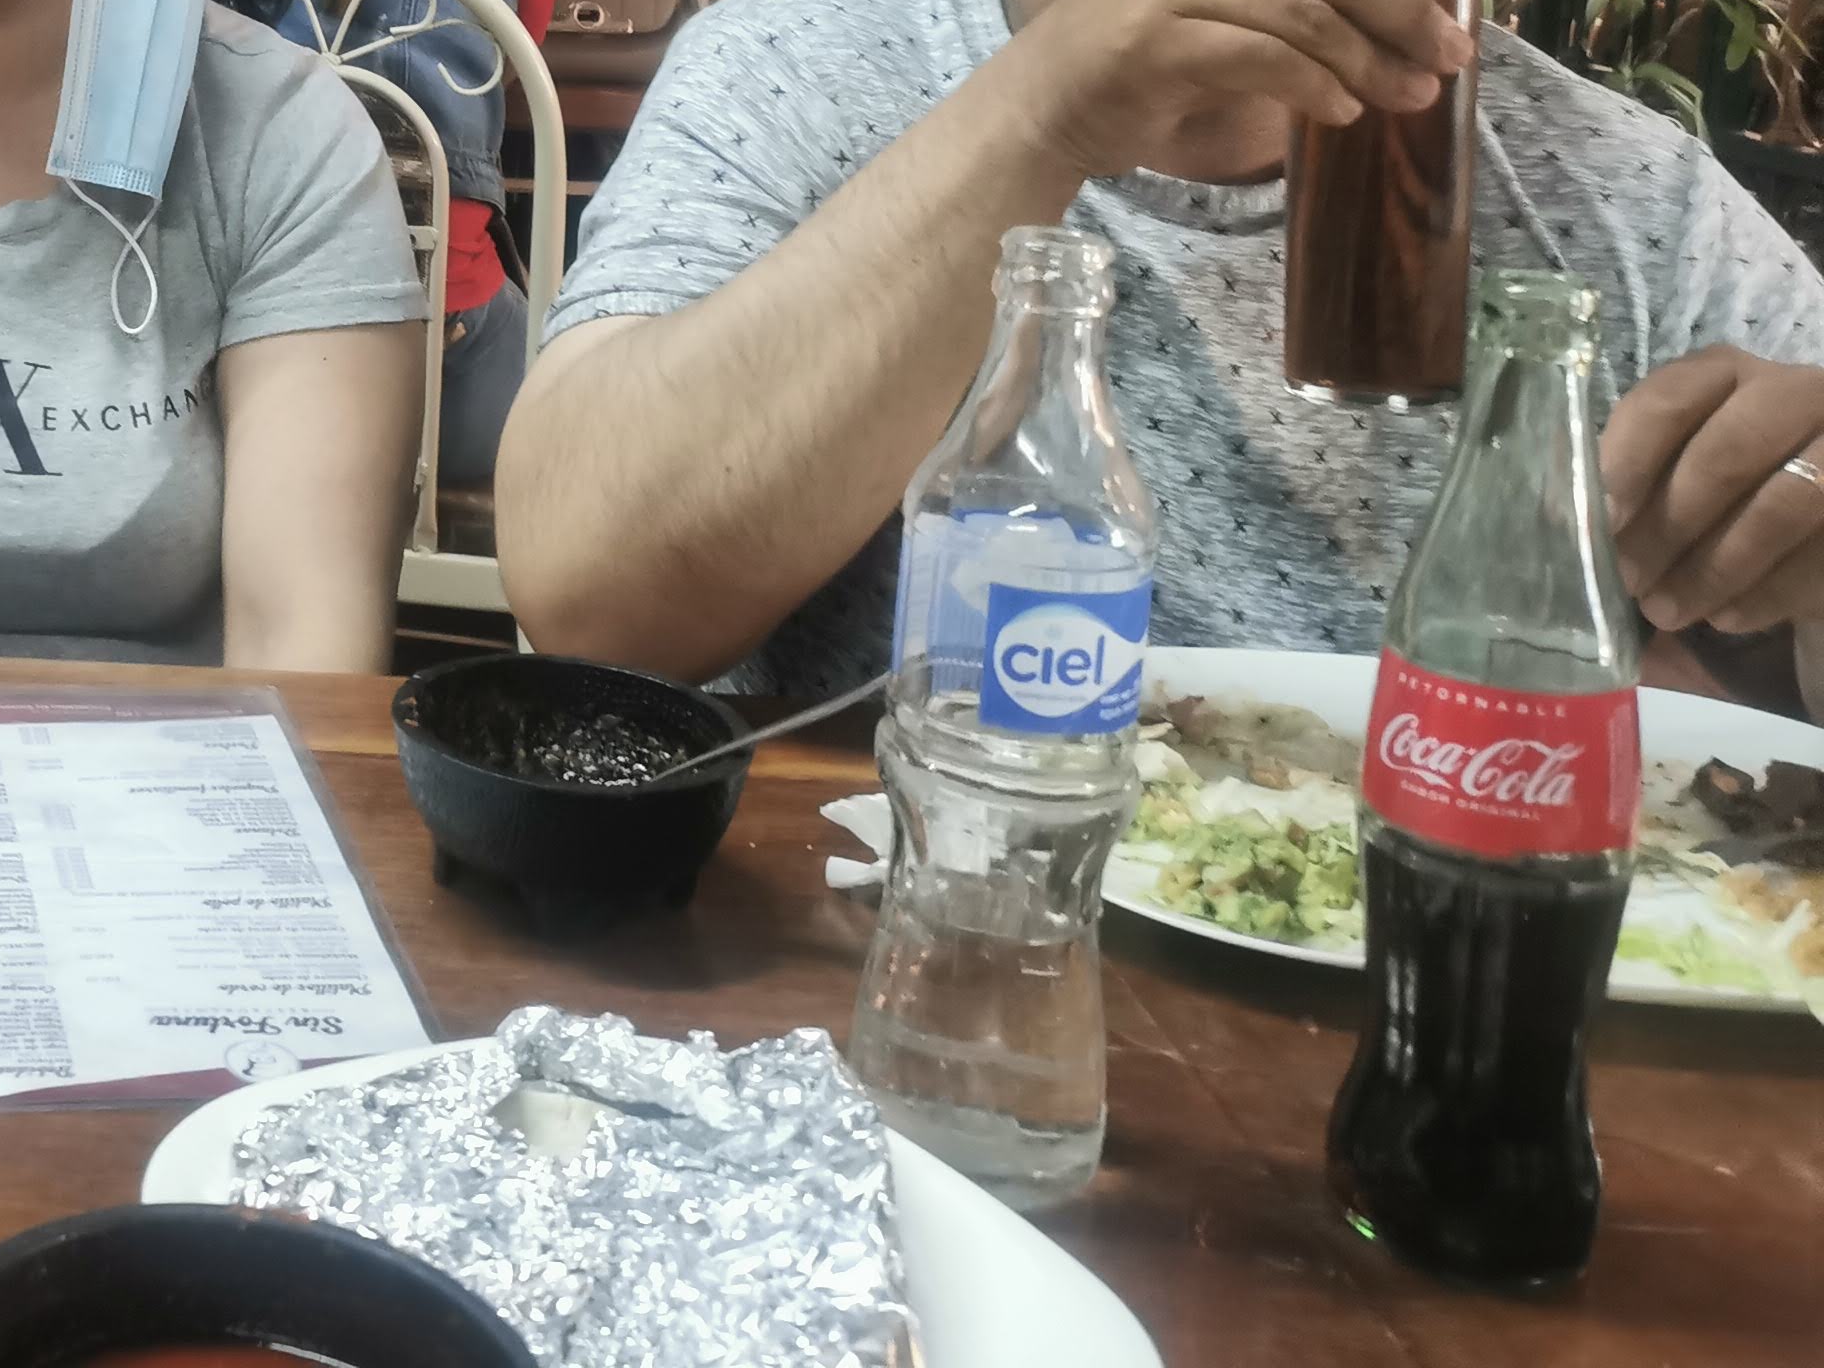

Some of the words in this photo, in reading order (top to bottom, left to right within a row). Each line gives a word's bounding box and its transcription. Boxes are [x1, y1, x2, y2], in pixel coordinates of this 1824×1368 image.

[1001, 634, 1106, 686] ciel
[1397, 671, 1567, 718] RETORNABLE
[1379, 712, 1586, 807] Coca-Cola
[149, 1014, 282, 1036] Fortuna
[286, 1015, 344, 1036] Sin
